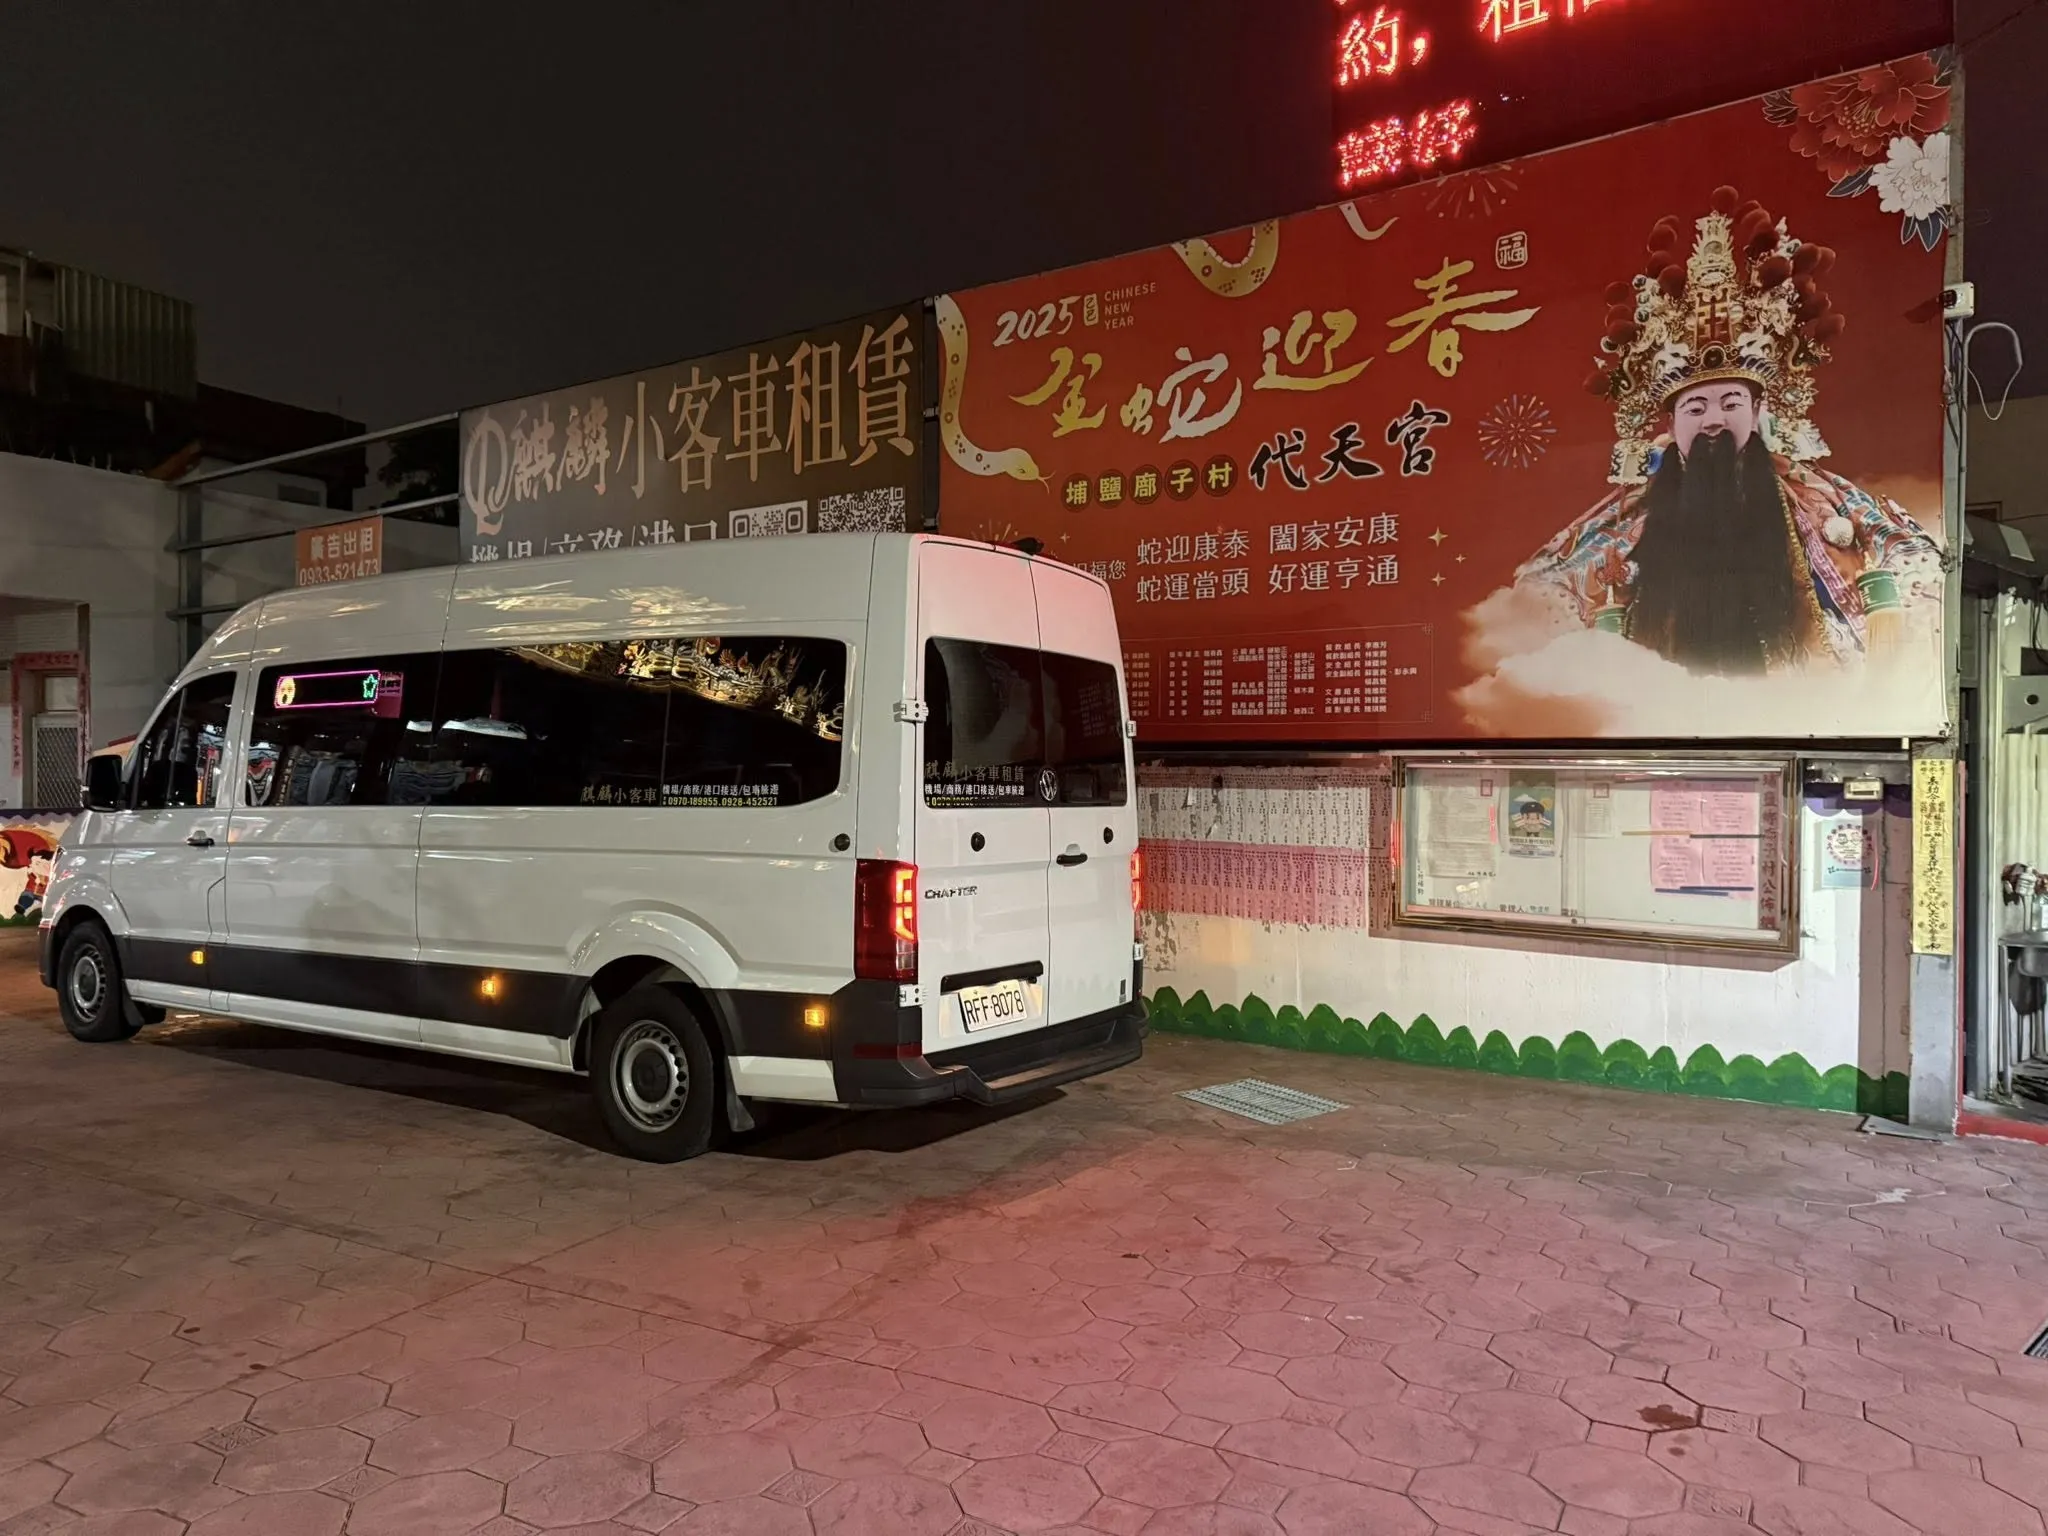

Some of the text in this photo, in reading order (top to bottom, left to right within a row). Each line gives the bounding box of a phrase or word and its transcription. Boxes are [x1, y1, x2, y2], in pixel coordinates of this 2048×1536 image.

[1104, 282, 1157, 301] CHINESE
[1104, 302, 1131, 316] NEW
[993, 295, 1081, 347] 2025
[1104, 317, 1134, 330] YEAR
[1250, 400, 1450, 491] 代天宮
[1137, 511, 1400, 566] 蛇迎康泰 闔家安康
[1136, 553, 1400, 604] 蛇運當頭 好運亨通
[964, 989, 1025, 1026] RFF-8078
